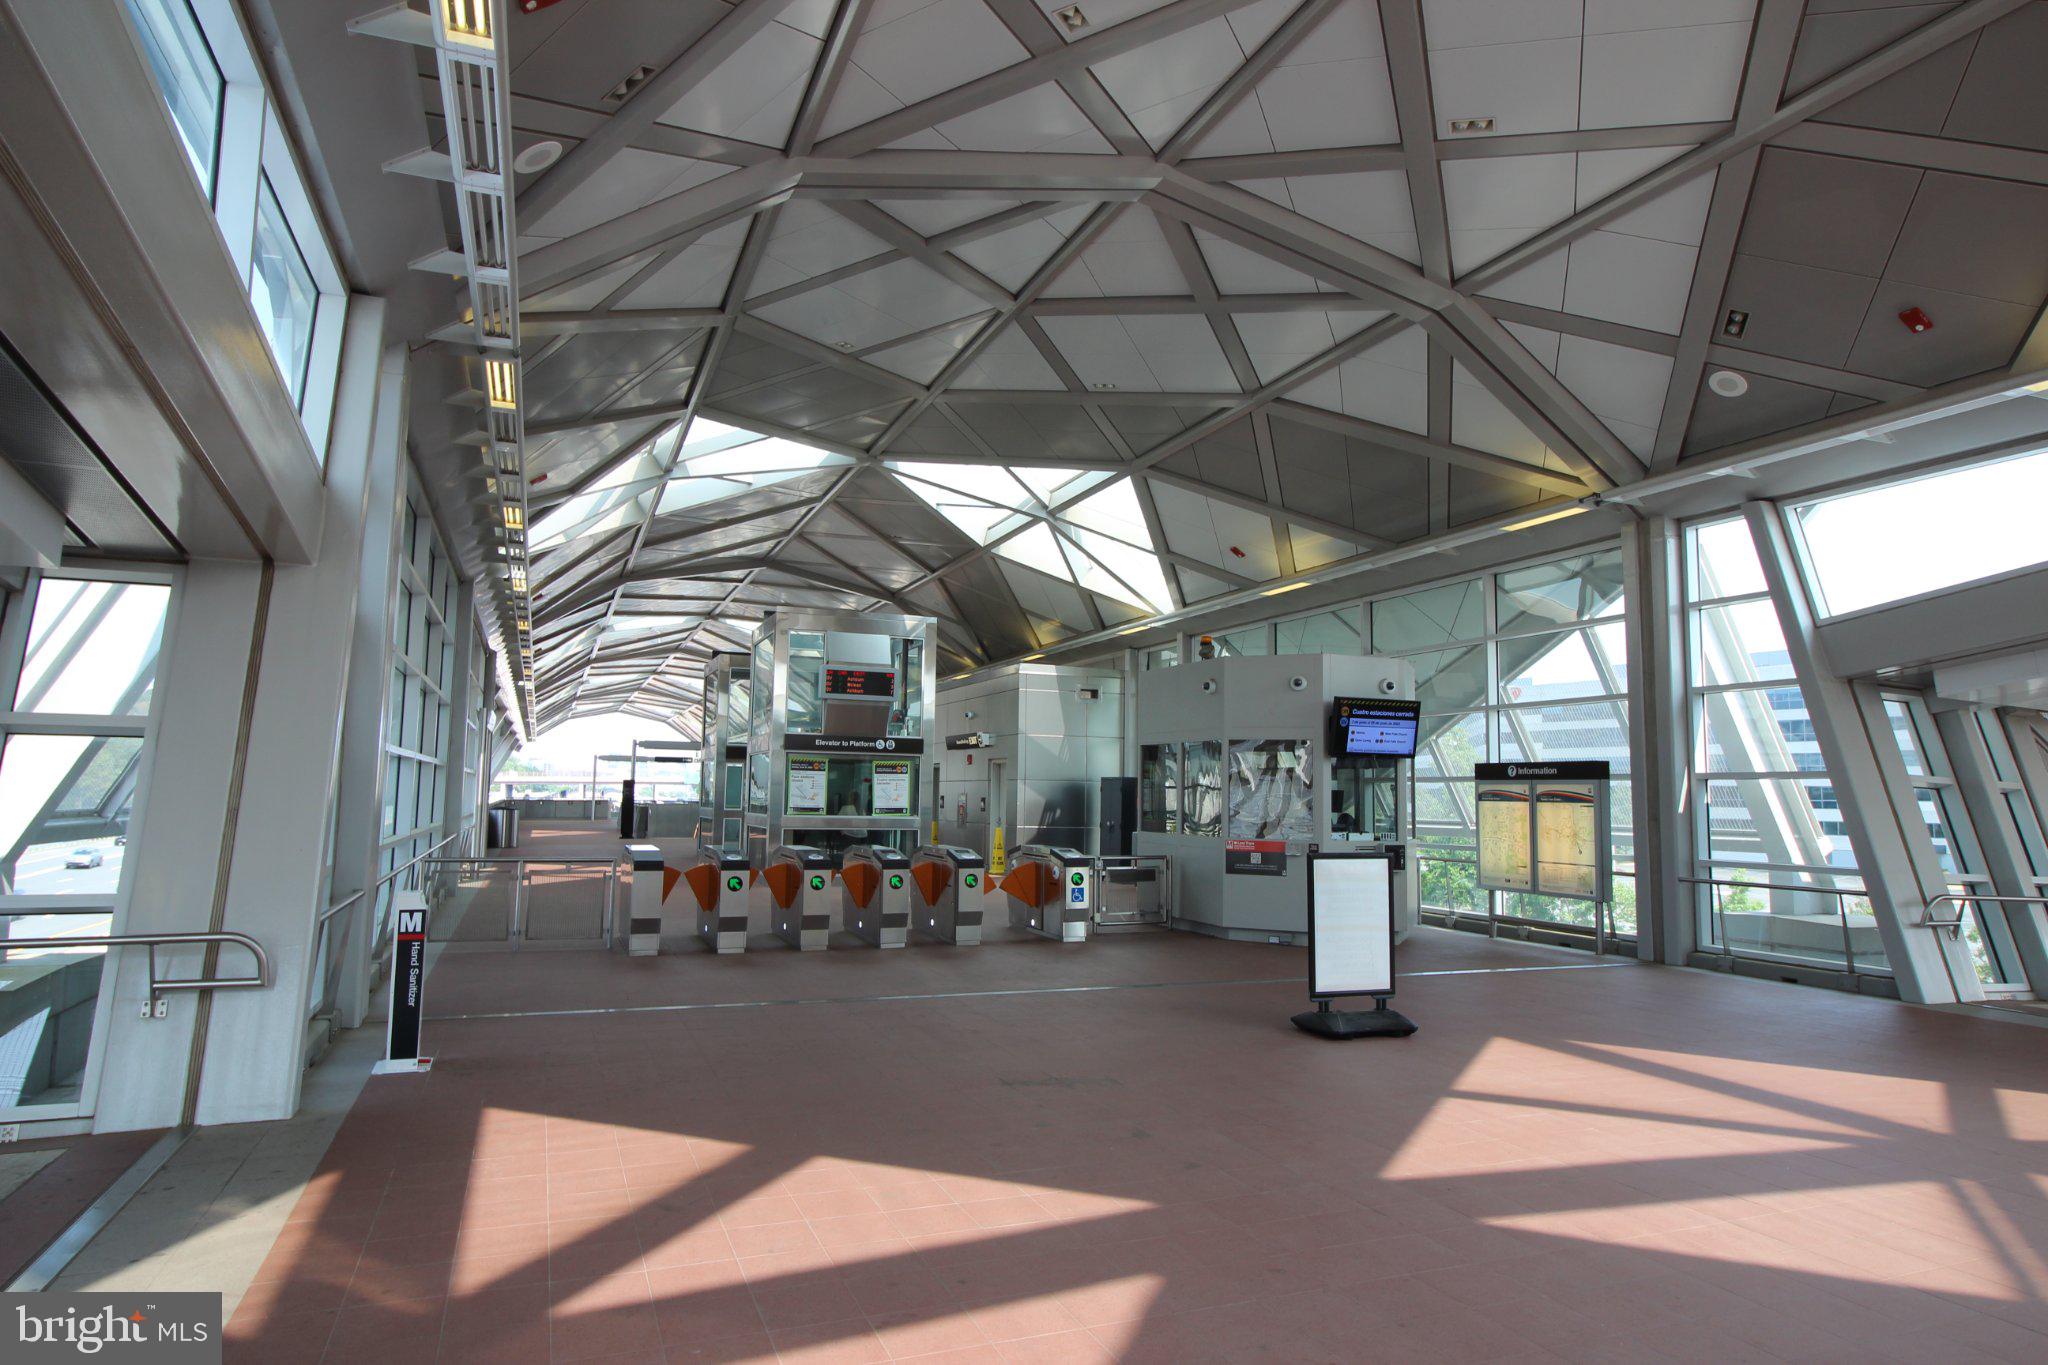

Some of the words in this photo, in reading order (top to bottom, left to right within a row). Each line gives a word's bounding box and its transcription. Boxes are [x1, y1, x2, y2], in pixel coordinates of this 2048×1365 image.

[1518, 767, 1557, 775] Information
[400, 912, 422, 932] M
[411, 941, 421, 966] Hand
[408, 968, 419, 1007] Sanitizer
